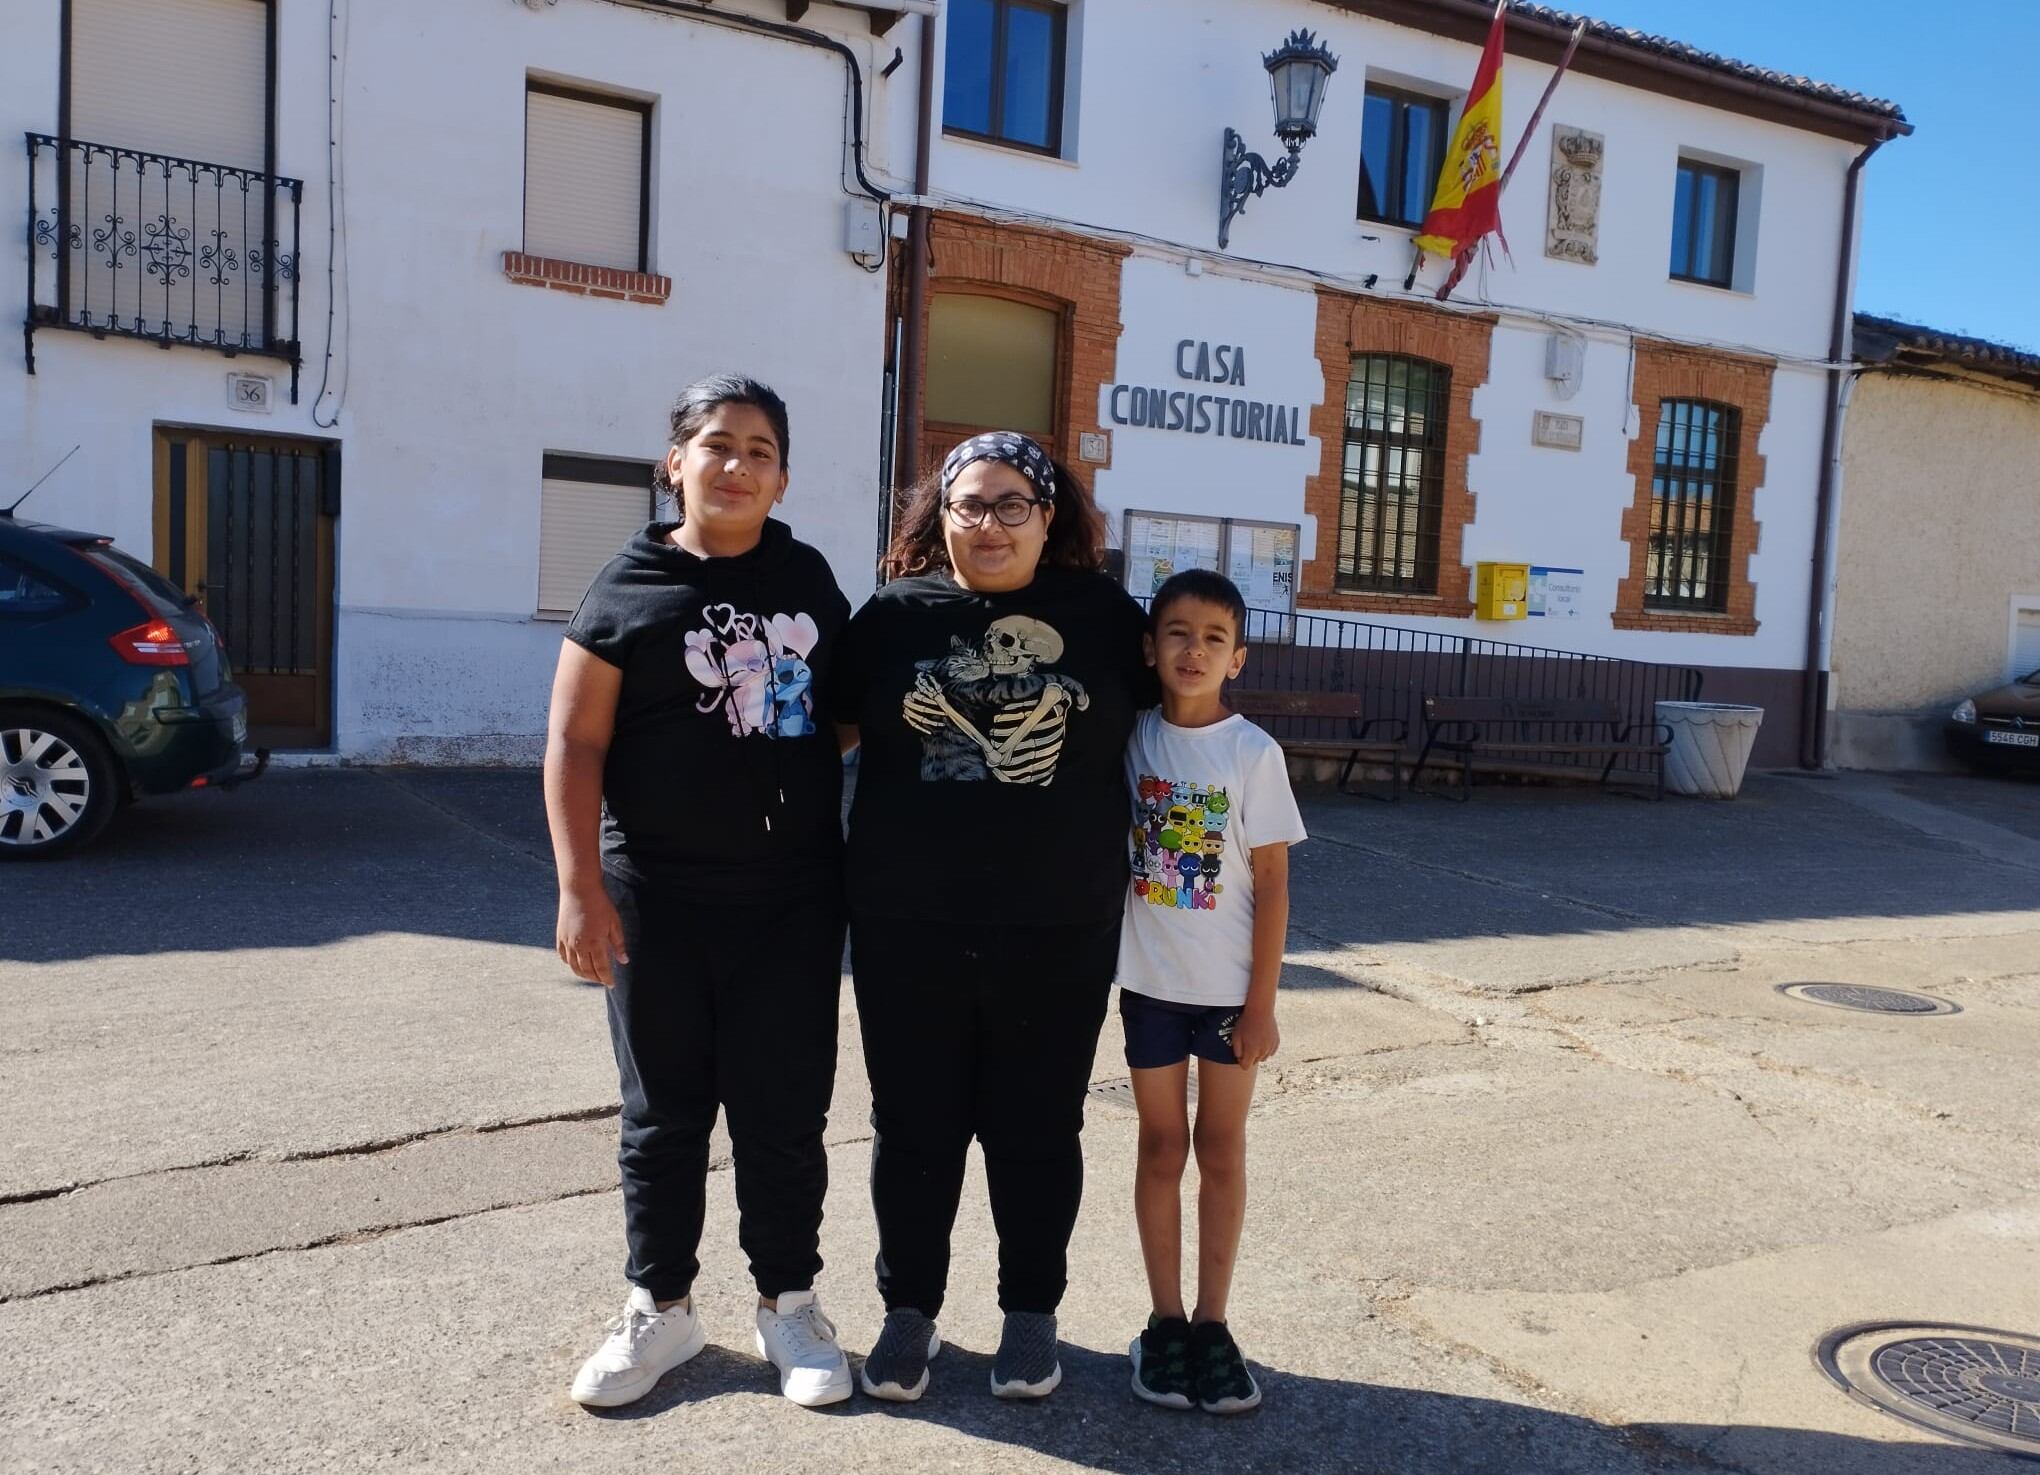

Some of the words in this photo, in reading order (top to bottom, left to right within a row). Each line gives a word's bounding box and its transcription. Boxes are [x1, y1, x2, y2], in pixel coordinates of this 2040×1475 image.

[1177, 339, 1246, 386] CASA
[240, 383, 261, 402] 36
[1110, 384, 1306, 446] CONSISTORIAL
